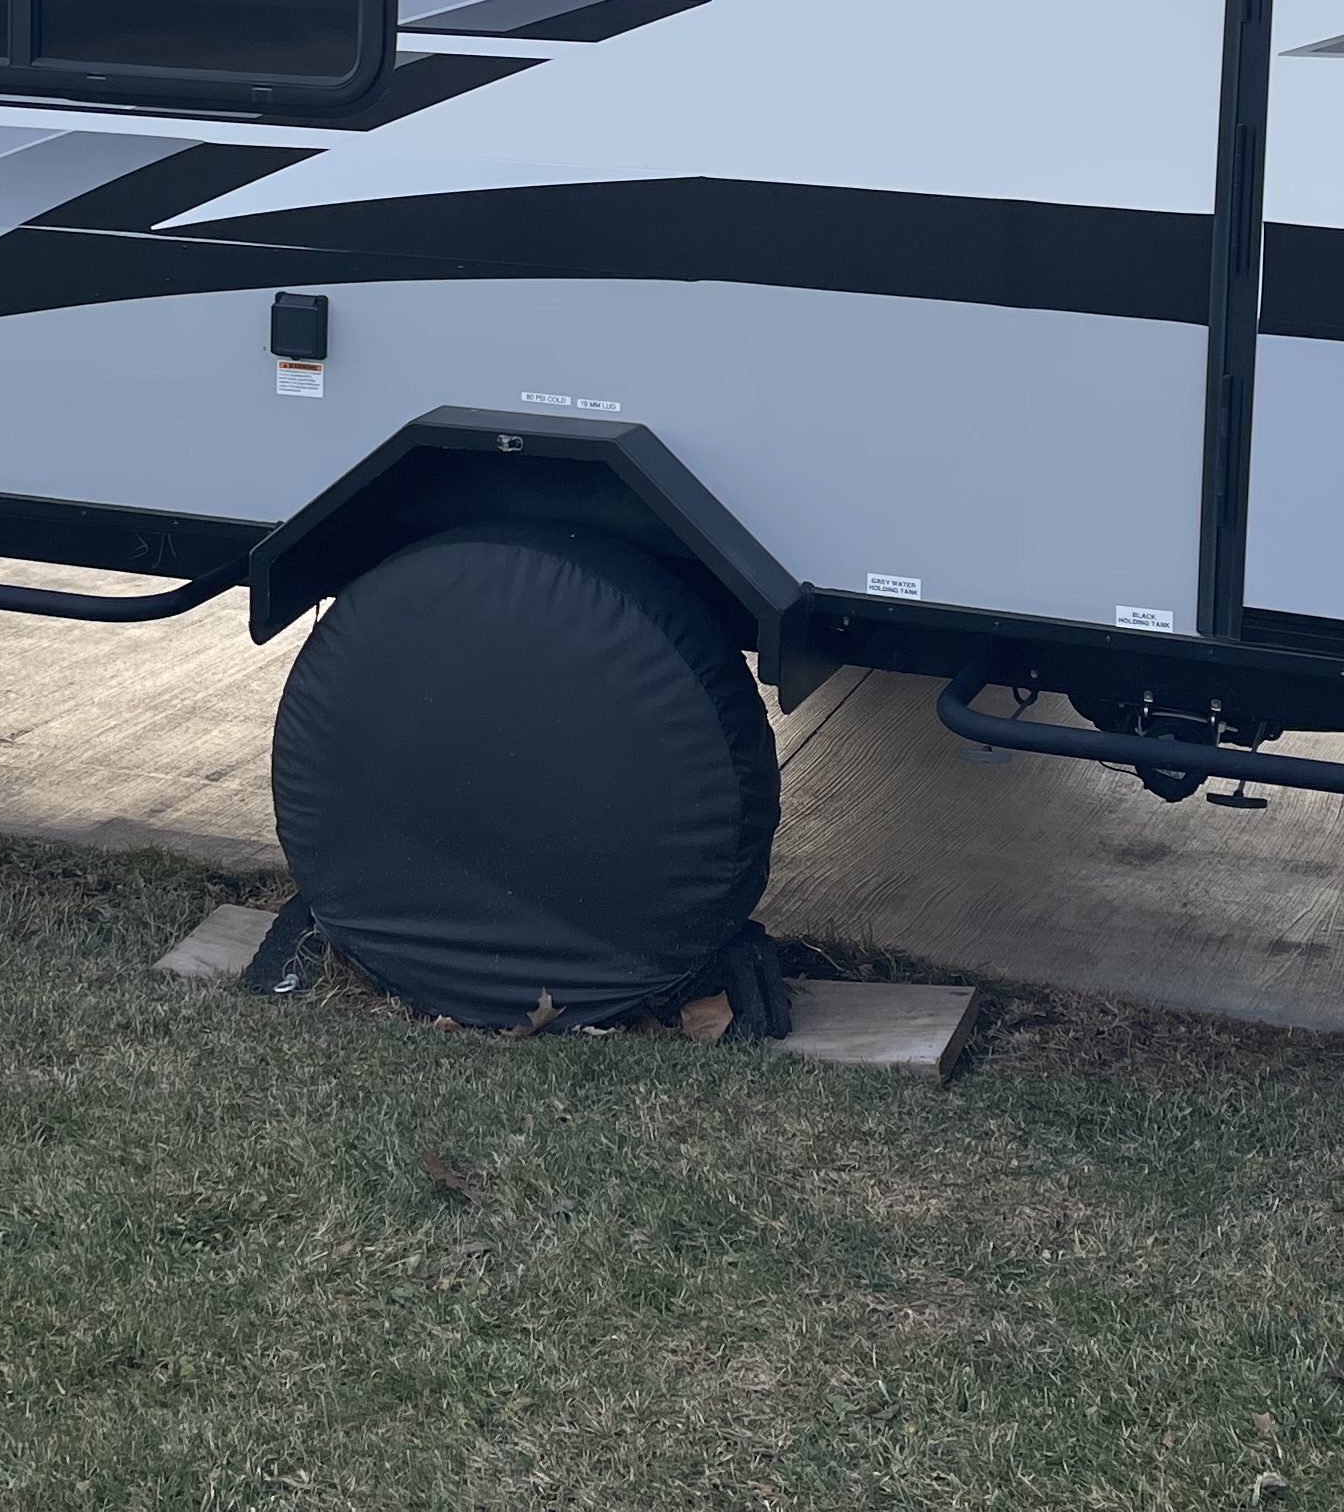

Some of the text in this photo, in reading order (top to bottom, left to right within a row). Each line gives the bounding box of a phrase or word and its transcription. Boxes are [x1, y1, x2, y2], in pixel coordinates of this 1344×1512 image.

[547, 396, 567, 404] COLD
[602, 402, 616, 410] LUG
[892, 580, 916, 588] WATER
[869, 584, 919, 596] HOLDING TANK
[1132, 611, 1157, 620] BLACK
[1118, 617, 1171, 629] HOLDING TANK
